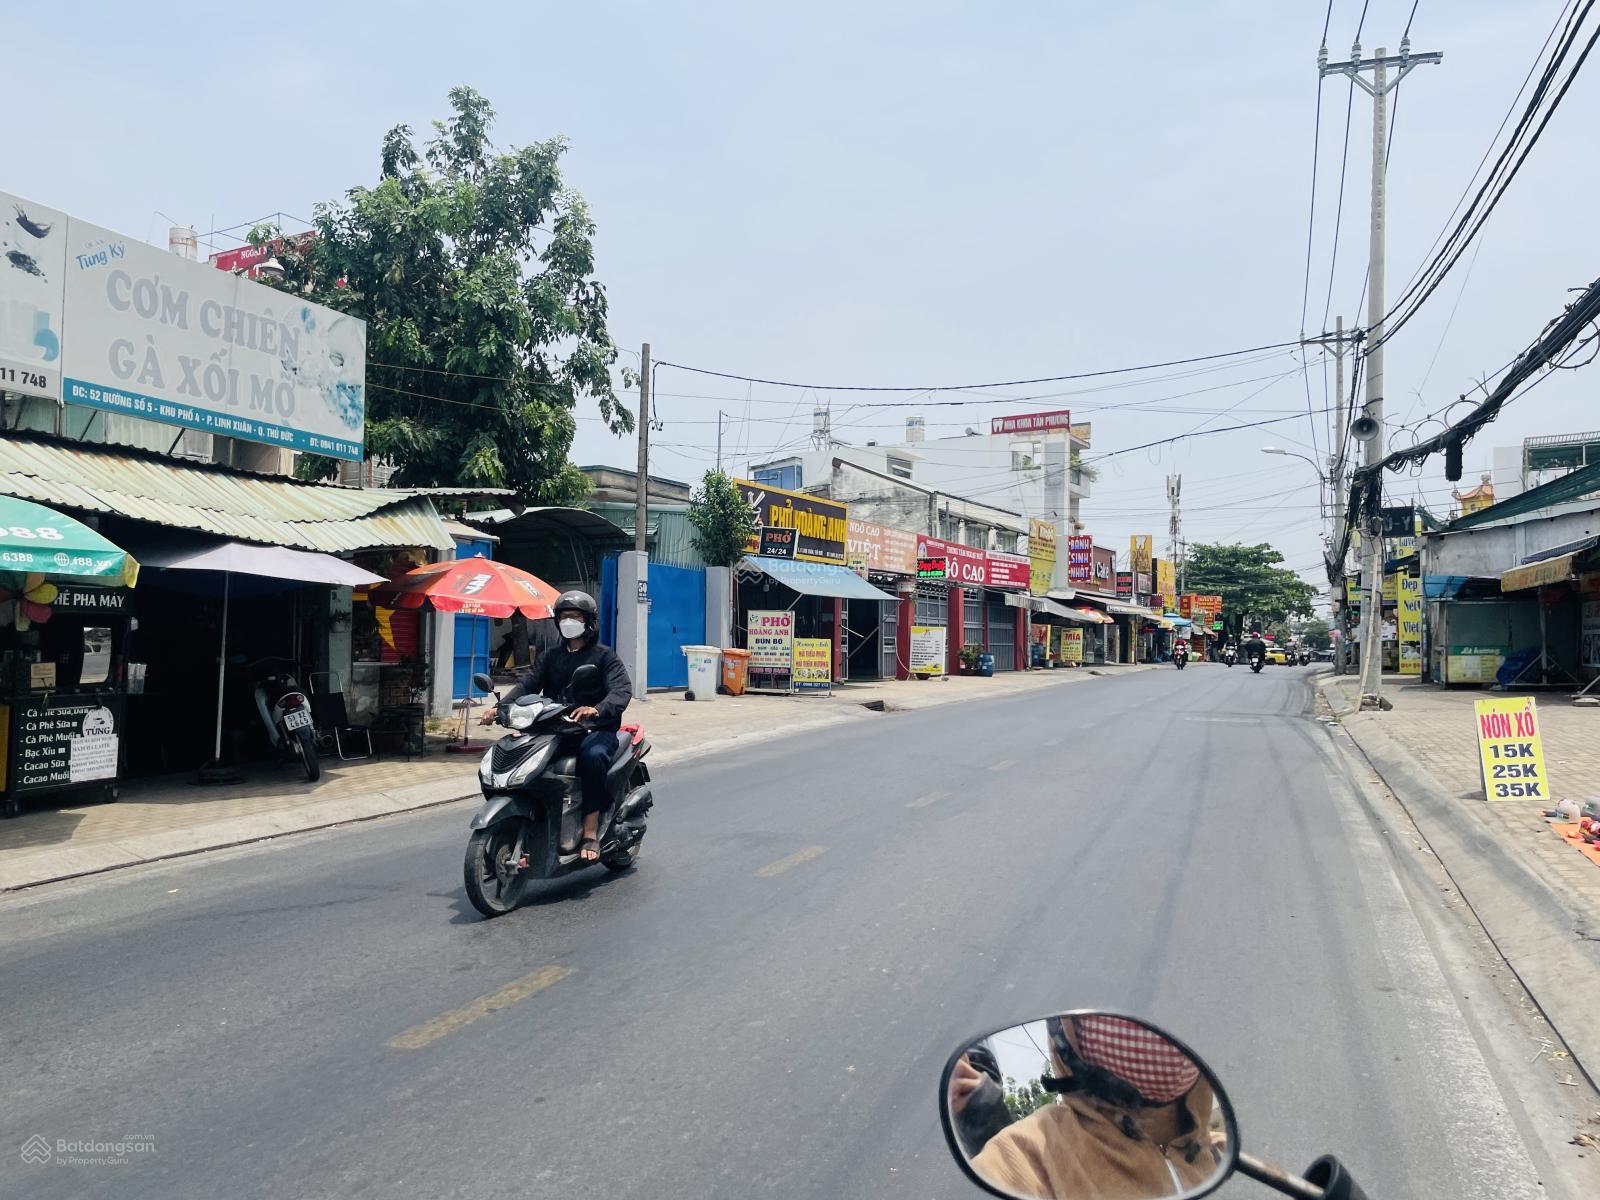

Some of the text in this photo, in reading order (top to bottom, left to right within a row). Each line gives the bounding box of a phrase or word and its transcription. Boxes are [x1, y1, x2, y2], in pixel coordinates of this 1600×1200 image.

[106, 269, 301, 362] CƠM CHIÊN
[108, 334, 166, 389] GÀ
[176, 348, 240, 406] XỐI
[21, 371, 47, 388] 748
[90, 389, 101, 401] 52
[147, 402, 153, 413] 5
[160, 405, 176, 418] KHU
[214, 417, 232, 430] LINH
[770, 499, 793, 528] PHỞ
[827, 517, 846, 542] ANH
[1071, 553, 1089, 563] SINH
[963, 564, 985, 581] CAO
[73, 593, 96, 606] PHA
[99, 592, 124, 607] MÁY
[761, 613, 790, 627] PHỞ
[1480, 708, 1512, 739] NÓN
[1489, 743, 1534, 758] 15K
[24, 761, 48, 771] Cacao
[1493, 763, 1538, 778] 25K
[24, 775, 48, 784] Cacao
[1495, 782, 1541, 797] 35K
